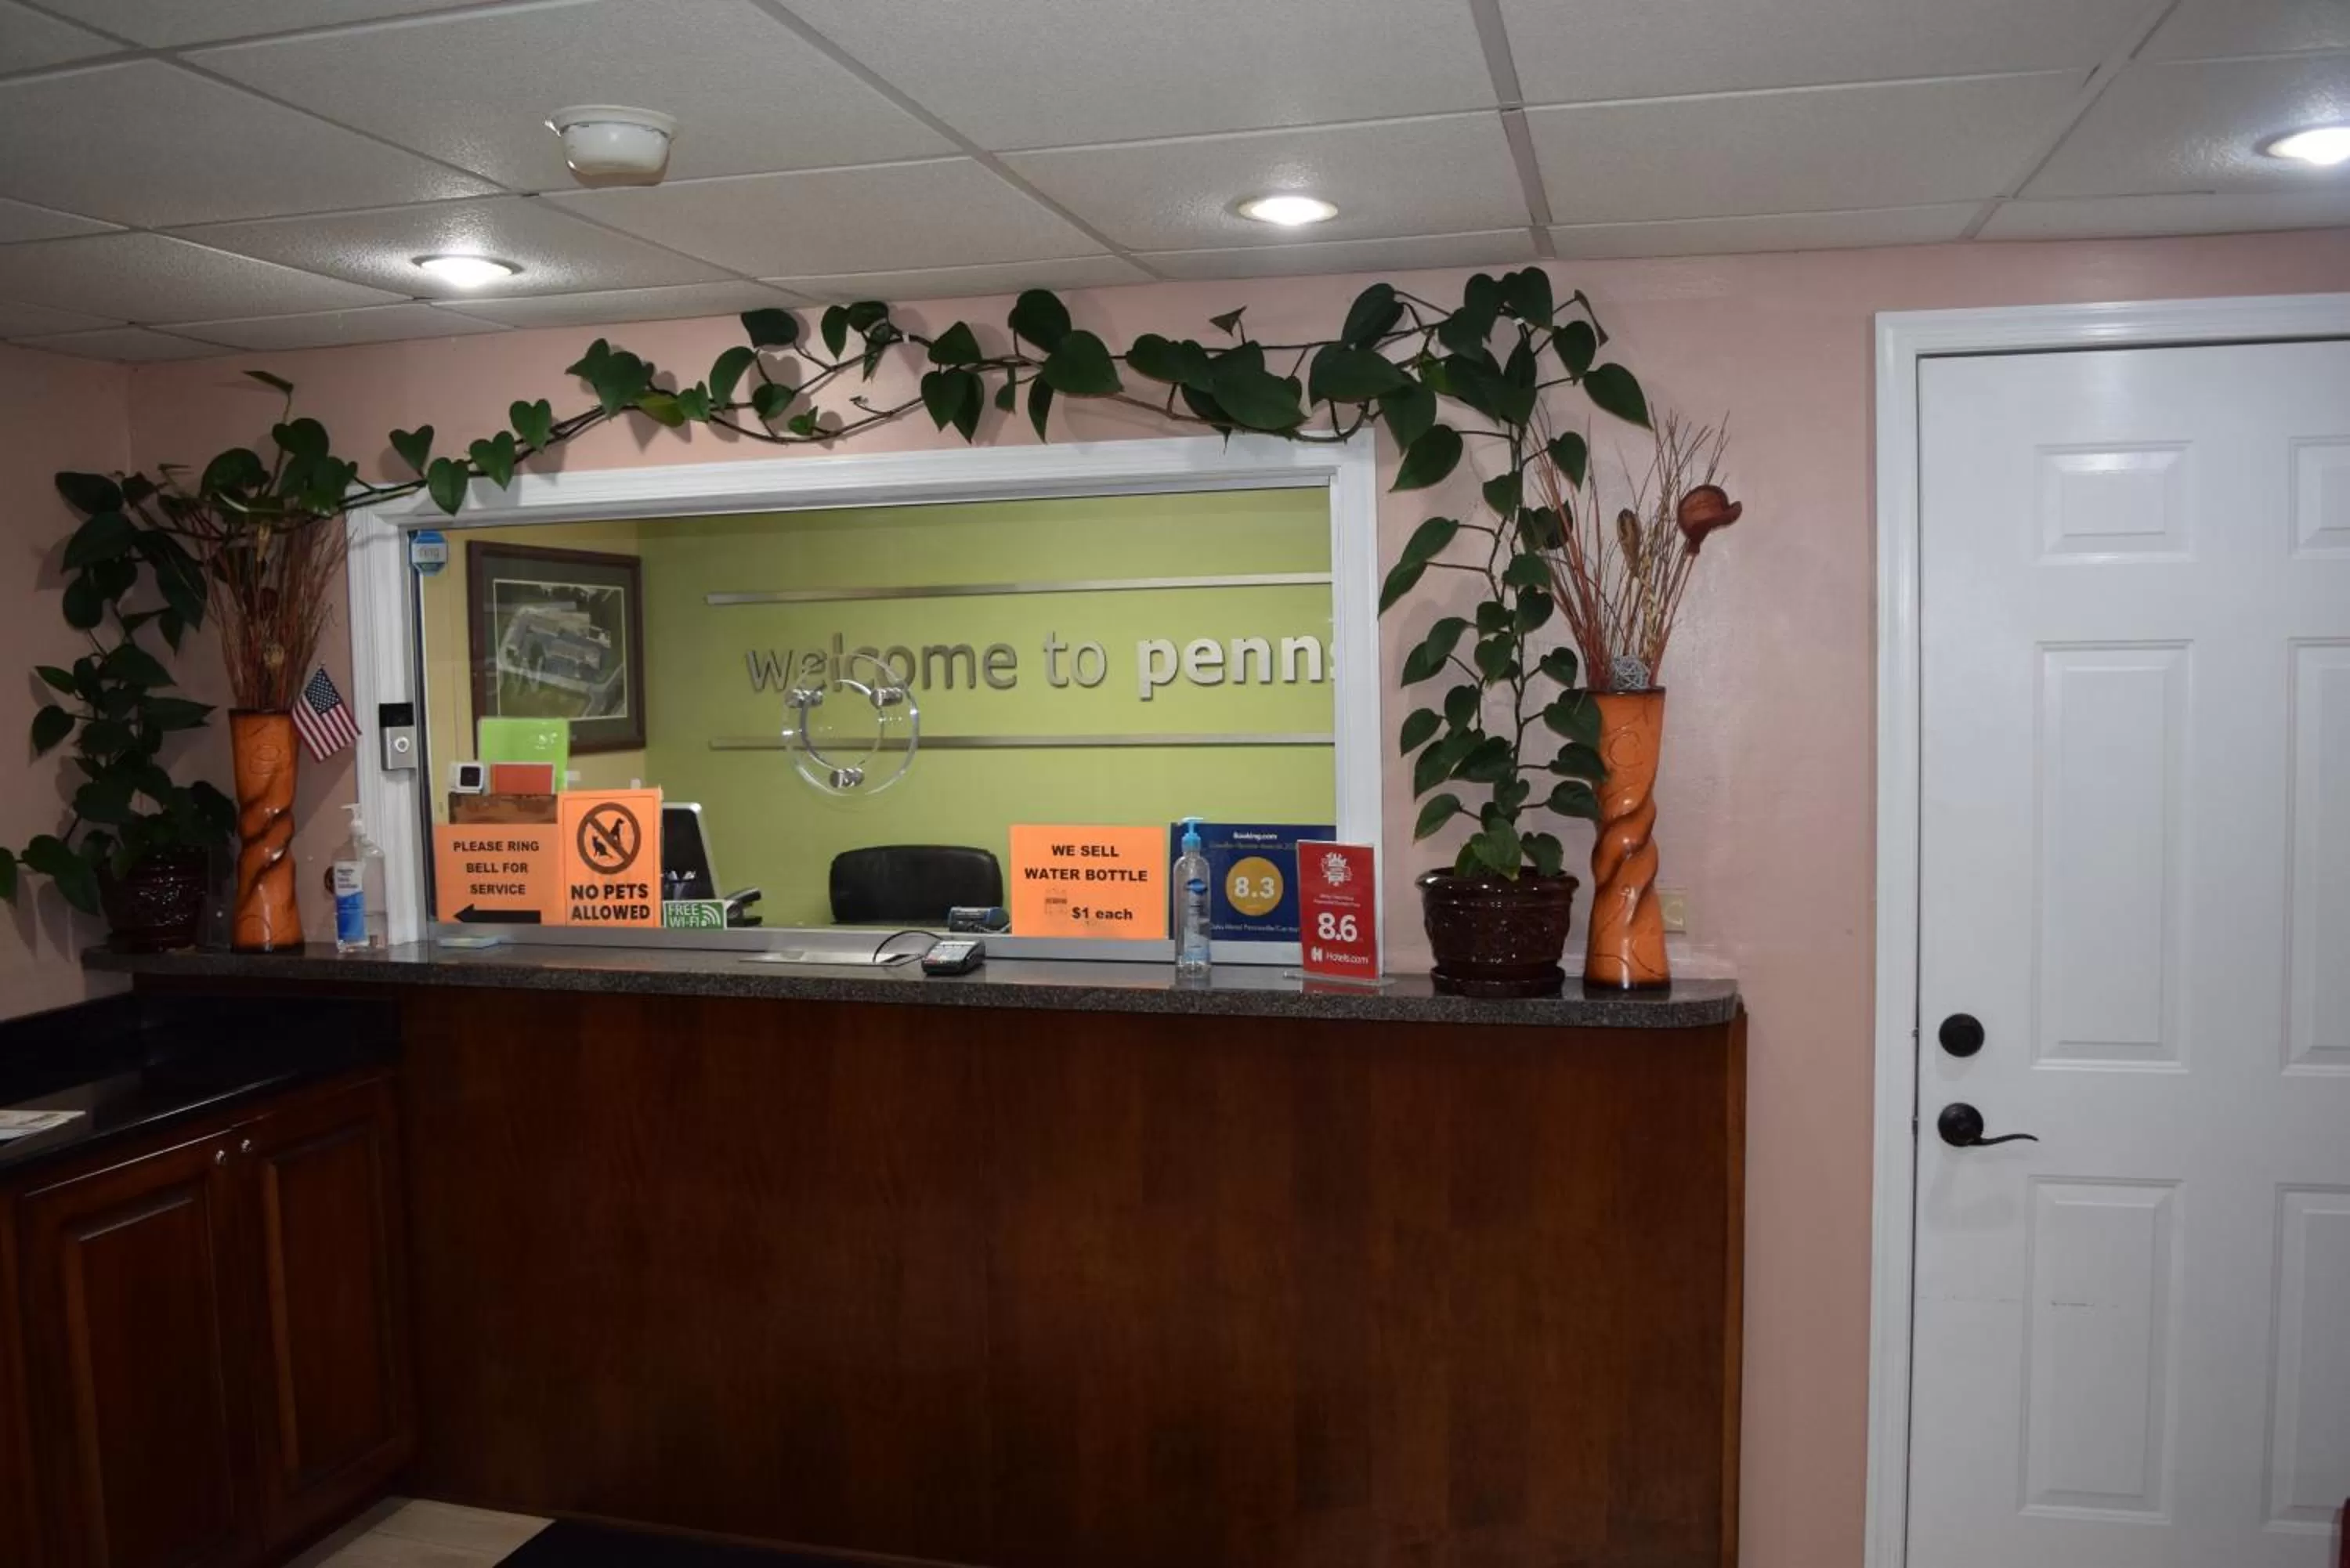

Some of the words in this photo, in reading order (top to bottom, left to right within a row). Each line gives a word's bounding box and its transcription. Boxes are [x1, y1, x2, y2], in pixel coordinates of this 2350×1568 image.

[746, 632, 1017, 692] welcome
[1043, 631, 1108, 689] to
[1137, 635, 1333, 702] penn
[453, 840, 503, 852] PLEASE
[507, 840, 540, 852] RING
[1051, 844, 1076, 857] WE
[1080, 844, 1120, 858] SELL
[465, 862, 498, 874] BELL
[502, 862, 529, 874] FOR
[1024, 867, 1080, 880] WATER
[1085, 869, 1148, 882] BOTTLE
[469, 882, 526, 895] SERVICE
[570, 884, 598, 900] NO
[602, 883, 649, 900] PETS
[1234, 876, 1275, 900] 8.3
[571, 904, 651, 921] ALLOWED
[668, 902, 700, 916] FREE
[1071, 906, 1090, 919] $1
[1094, 908, 1133, 920] each
[669, 916, 700, 928] WI-FI
[1317, 912, 1358, 943] 8.6
